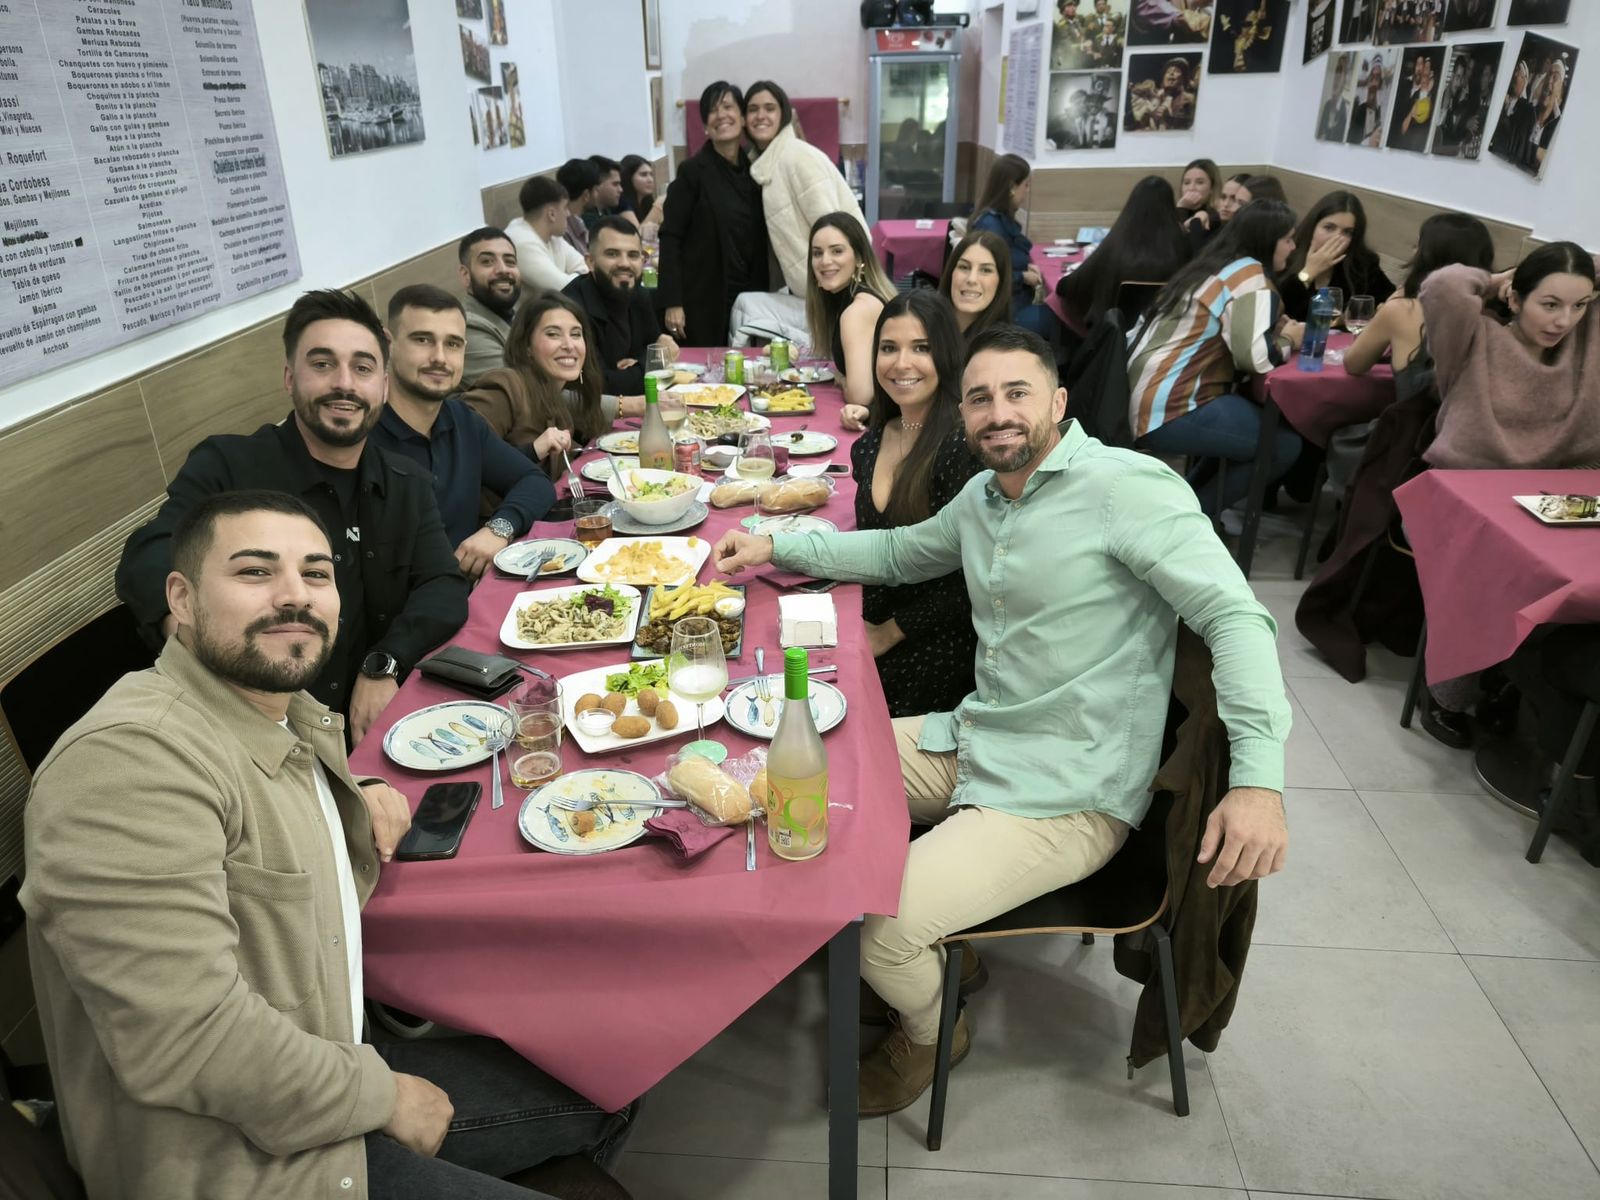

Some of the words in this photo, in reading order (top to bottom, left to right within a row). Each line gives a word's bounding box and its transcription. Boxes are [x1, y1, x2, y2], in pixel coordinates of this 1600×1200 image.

[133, 112, 156, 120] plancha
[138, 132, 160, 140] plancha
[140, 141, 162, 149] plancha
[7, 150, 47, 165] Roquefort
[157, 150, 179, 158] plancha
[149, 160, 171, 169] plancha
[155, 169, 177, 177] plancha
[9, 177, 51, 191] Cordobesa
[39, 193, 42, 203] y
[176, 222, 196, 232] plancha
[179, 250, 200, 260] plancha
[177, 262, 186, 270] por
[12, 279, 31, 290] Tabla
[33, 276, 40, 285] de
[42, 272, 61, 284] queso
[19, 291, 39, 304] Jamón
[41, 286, 62, 297] Ibérico
[32, 302, 56, 315] Mojama
[193, 300, 201, 308] por
[43, 342, 69, 355] Anchoas
